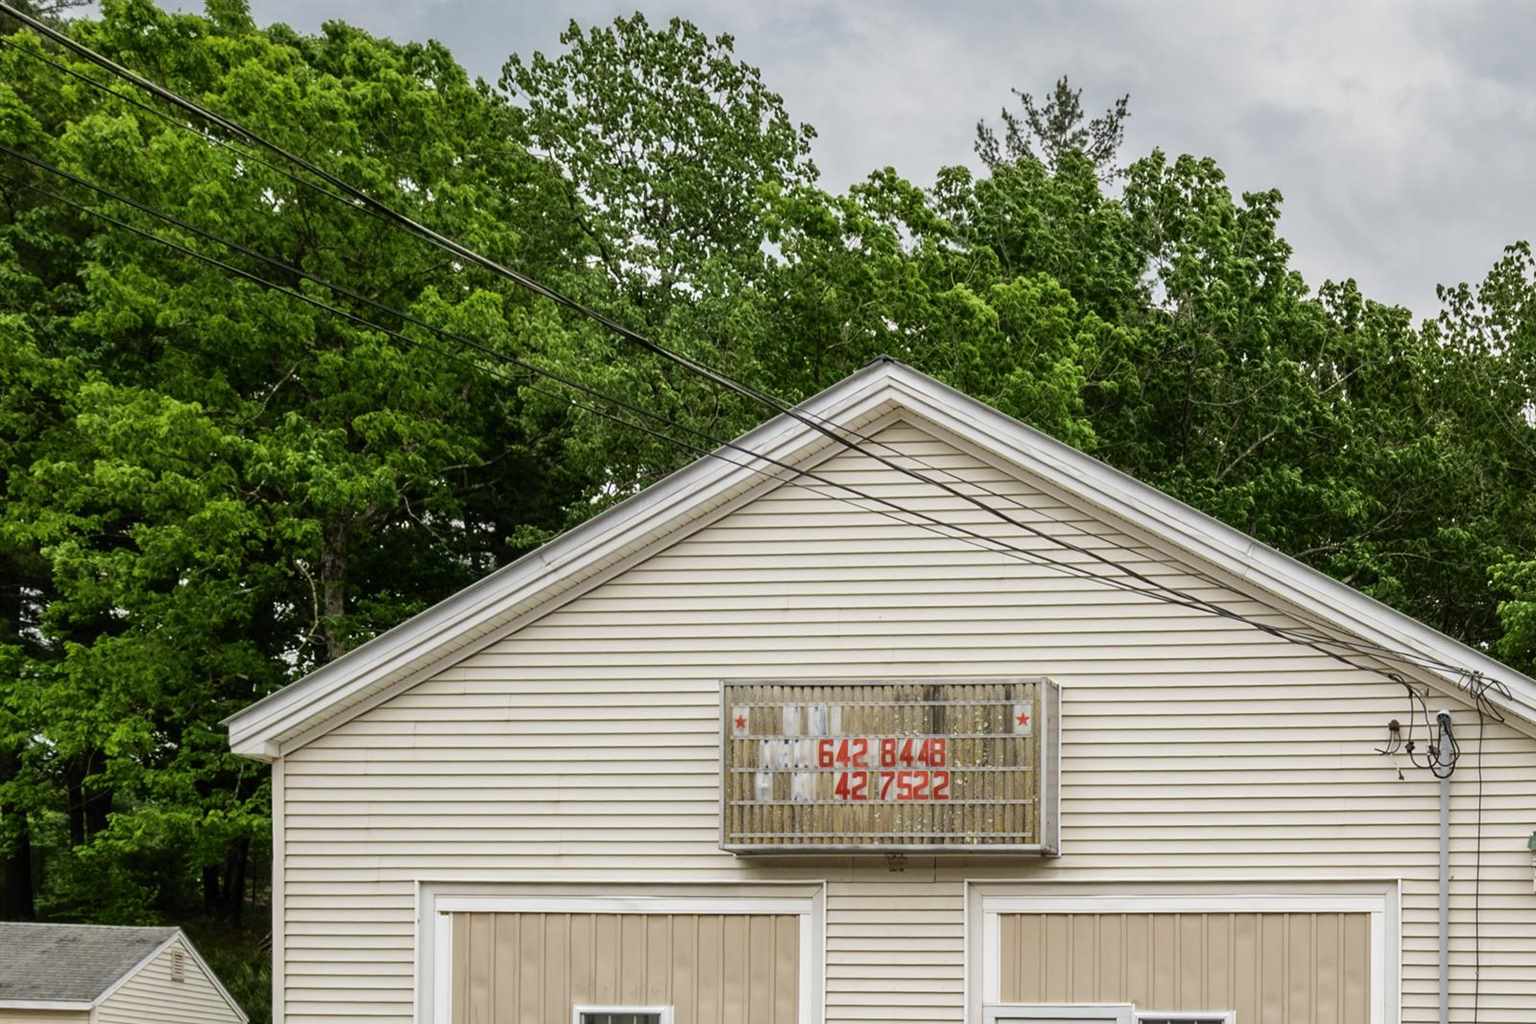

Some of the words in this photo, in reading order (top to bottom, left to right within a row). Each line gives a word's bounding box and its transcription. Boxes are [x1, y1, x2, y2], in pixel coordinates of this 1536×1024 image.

[818, 738, 868, 769] 642
[880, 738, 945, 768] 8448
[835, 771, 867, 800] 42
[880, 771, 950, 800] 7522
